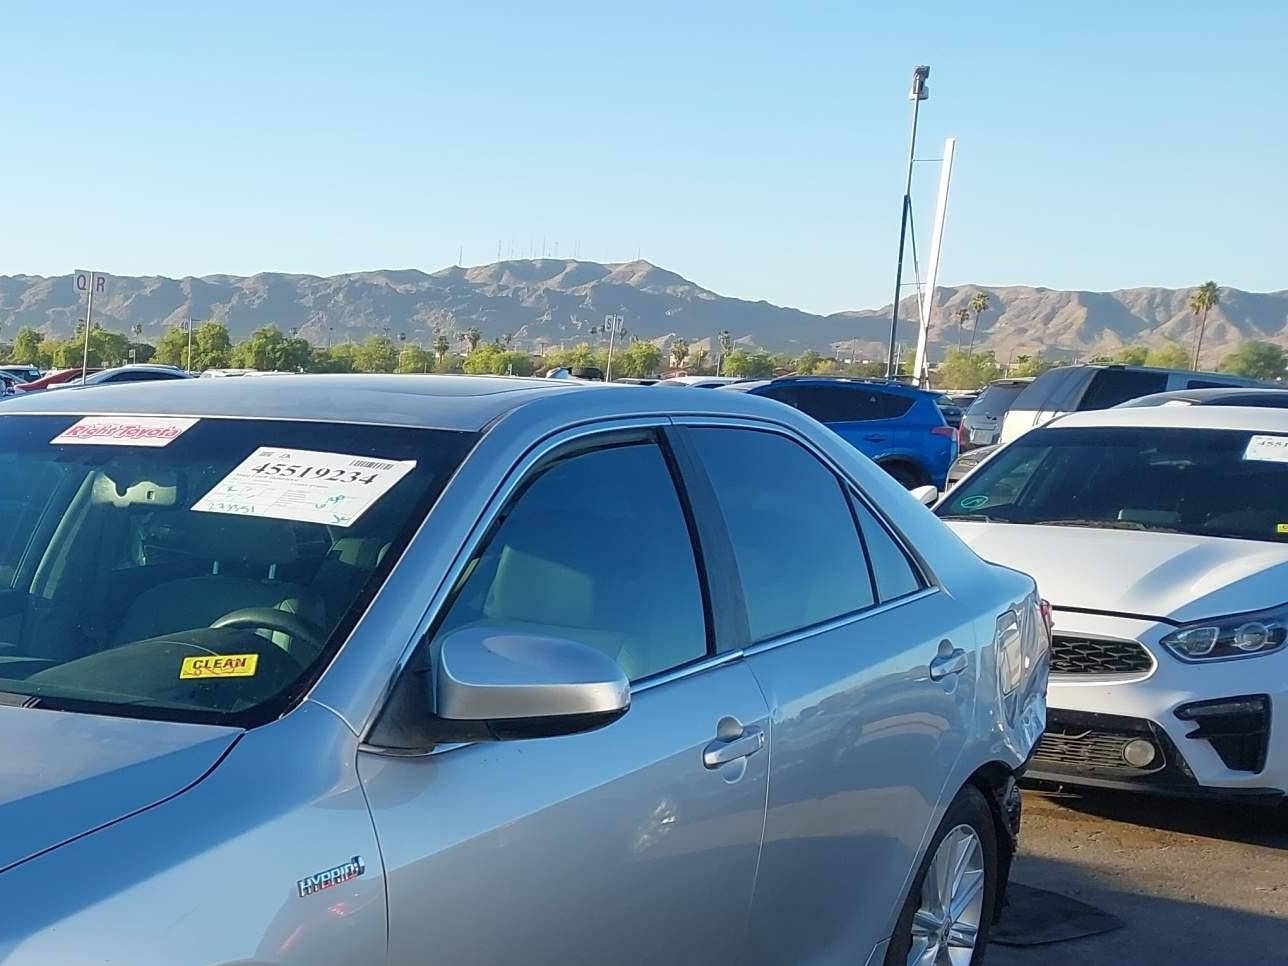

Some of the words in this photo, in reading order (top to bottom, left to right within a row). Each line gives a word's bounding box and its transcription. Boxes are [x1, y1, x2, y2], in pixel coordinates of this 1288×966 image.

[77, 274, 87, 290] Q
[96, 276, 105, 292] R
[65, 424, 119, 440] Right
[119, 424, 181, 440] Toyota
[251, 462, 379, 485] 45519234
[193, 657, 246, 670] CLEAN
[297, 862, 357, 897] HYBRID
